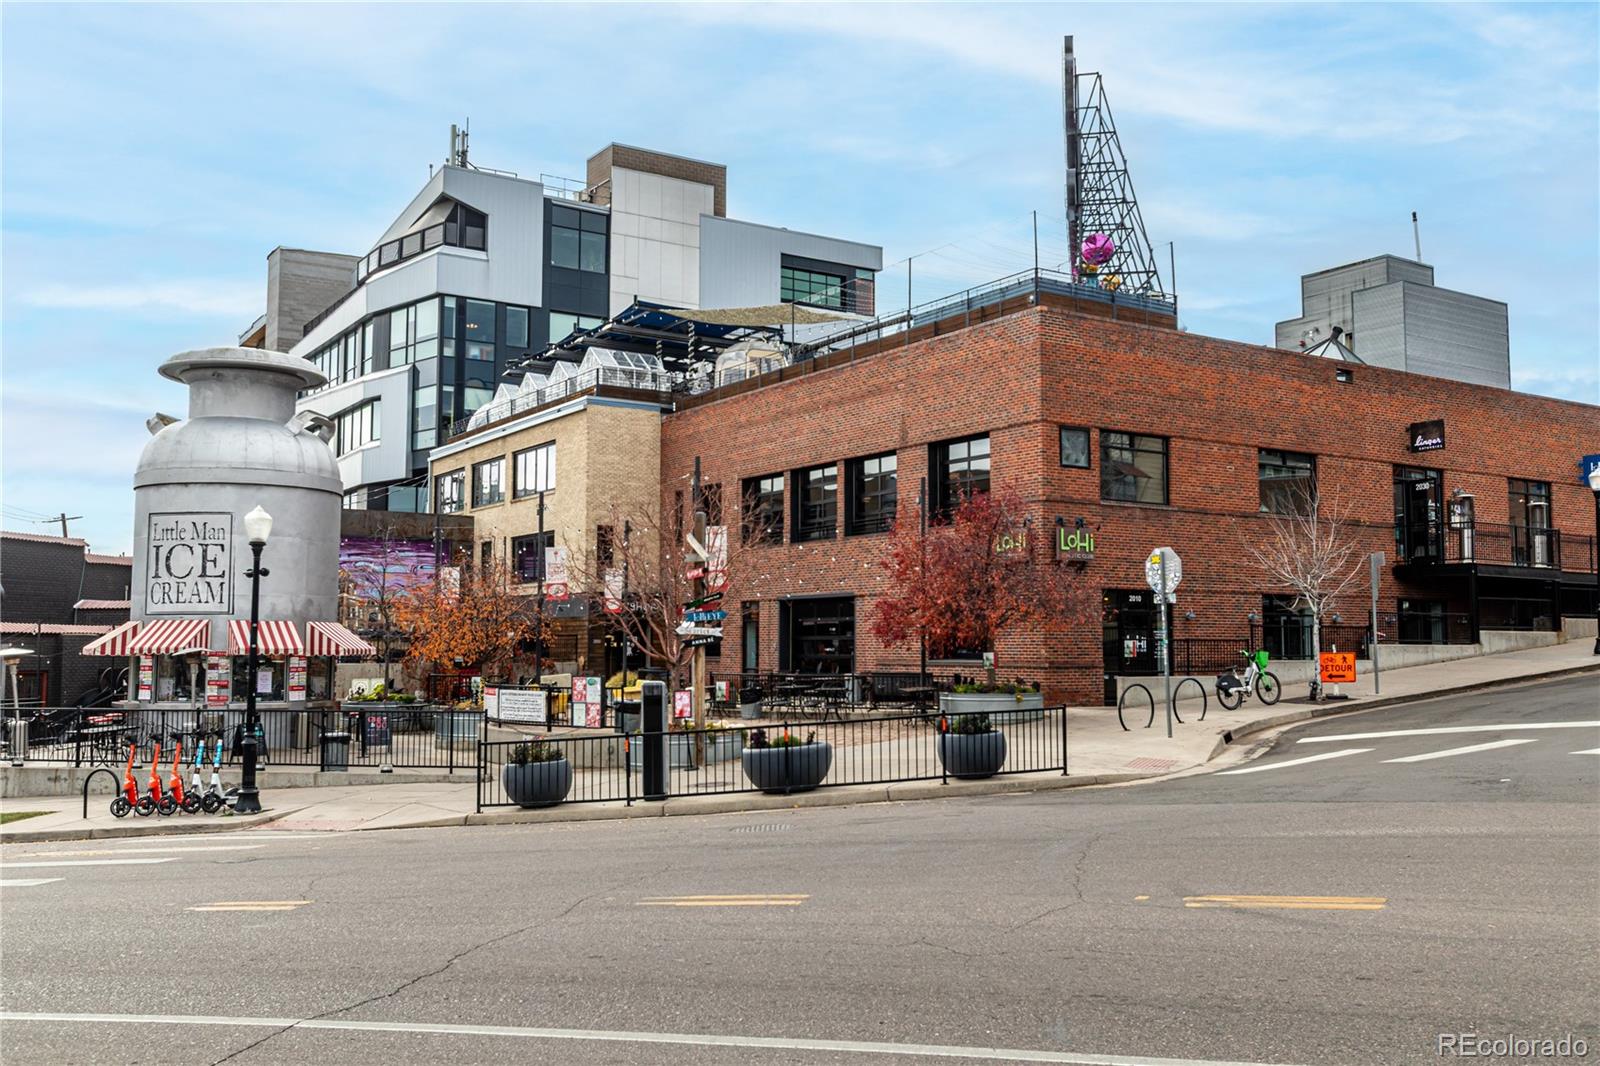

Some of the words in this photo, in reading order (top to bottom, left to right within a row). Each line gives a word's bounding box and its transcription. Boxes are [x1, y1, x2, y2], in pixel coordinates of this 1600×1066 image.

[1415, 483, 1430, 491] 2030
[152, 520, 187, 541] Little
[190, 521, 226, 540] Man
[1060, 527, 1095, 552] LoHi
[152, 542, 226, 579] ICE
[150, 580, 226, 604] CREAM
[1320, 664, 1353, 672] DETOUR
